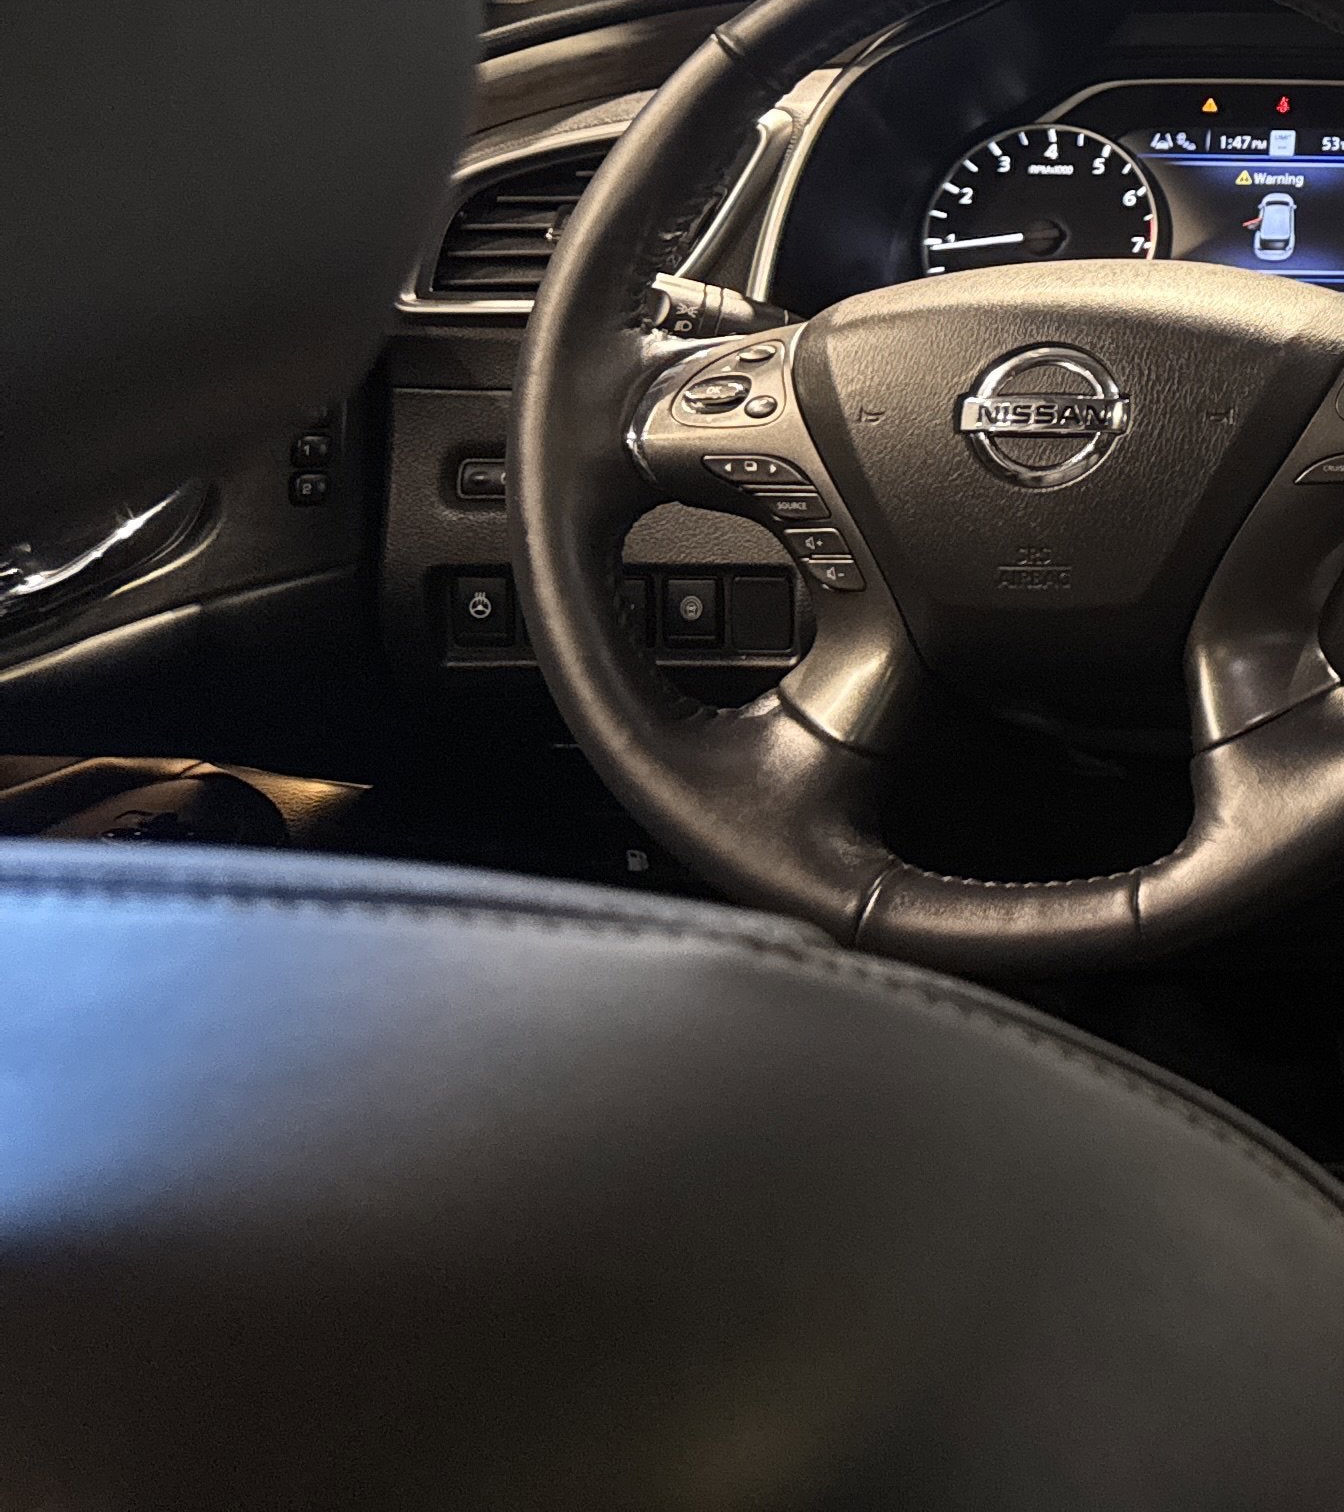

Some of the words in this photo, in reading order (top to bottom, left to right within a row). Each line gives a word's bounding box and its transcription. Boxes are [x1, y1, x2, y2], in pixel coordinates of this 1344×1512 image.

[1219, 135, 1251, 150] 1:47
[1043, 143, 1058, 160] 4
[997, 156, 1011, 173] 3
[1092, 157, 1106, 175] 5
[1253, 172, 1304, 187] Warning
[958, 187, 973, 205] 2
[1122, 190, 1137, 207] 6
[1131, 237, 1145, 254] 7
[977, 404, 1109, 426] NISSAN
[302, 484, 312, 495] 2
[776, 501, 807, 511] SOURCE
